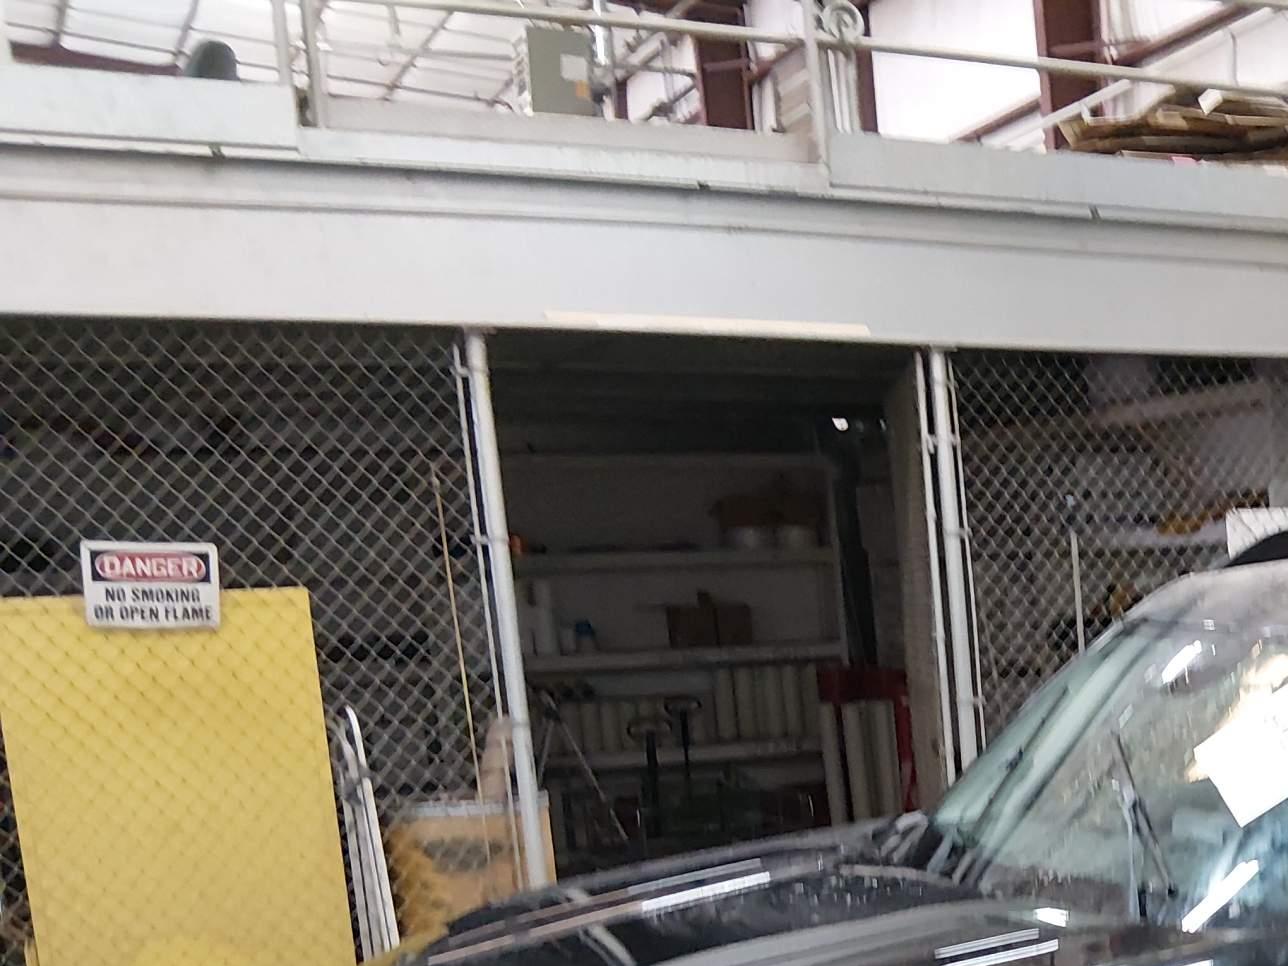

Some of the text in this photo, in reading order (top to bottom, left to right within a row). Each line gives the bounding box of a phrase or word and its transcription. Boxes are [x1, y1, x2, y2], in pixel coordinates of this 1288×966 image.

[103, 554, 199, 577] DANGER
[105, 587, 201, 603] NO SMOKING
[94, 605, 212, 621] OR OPEN FLAME
